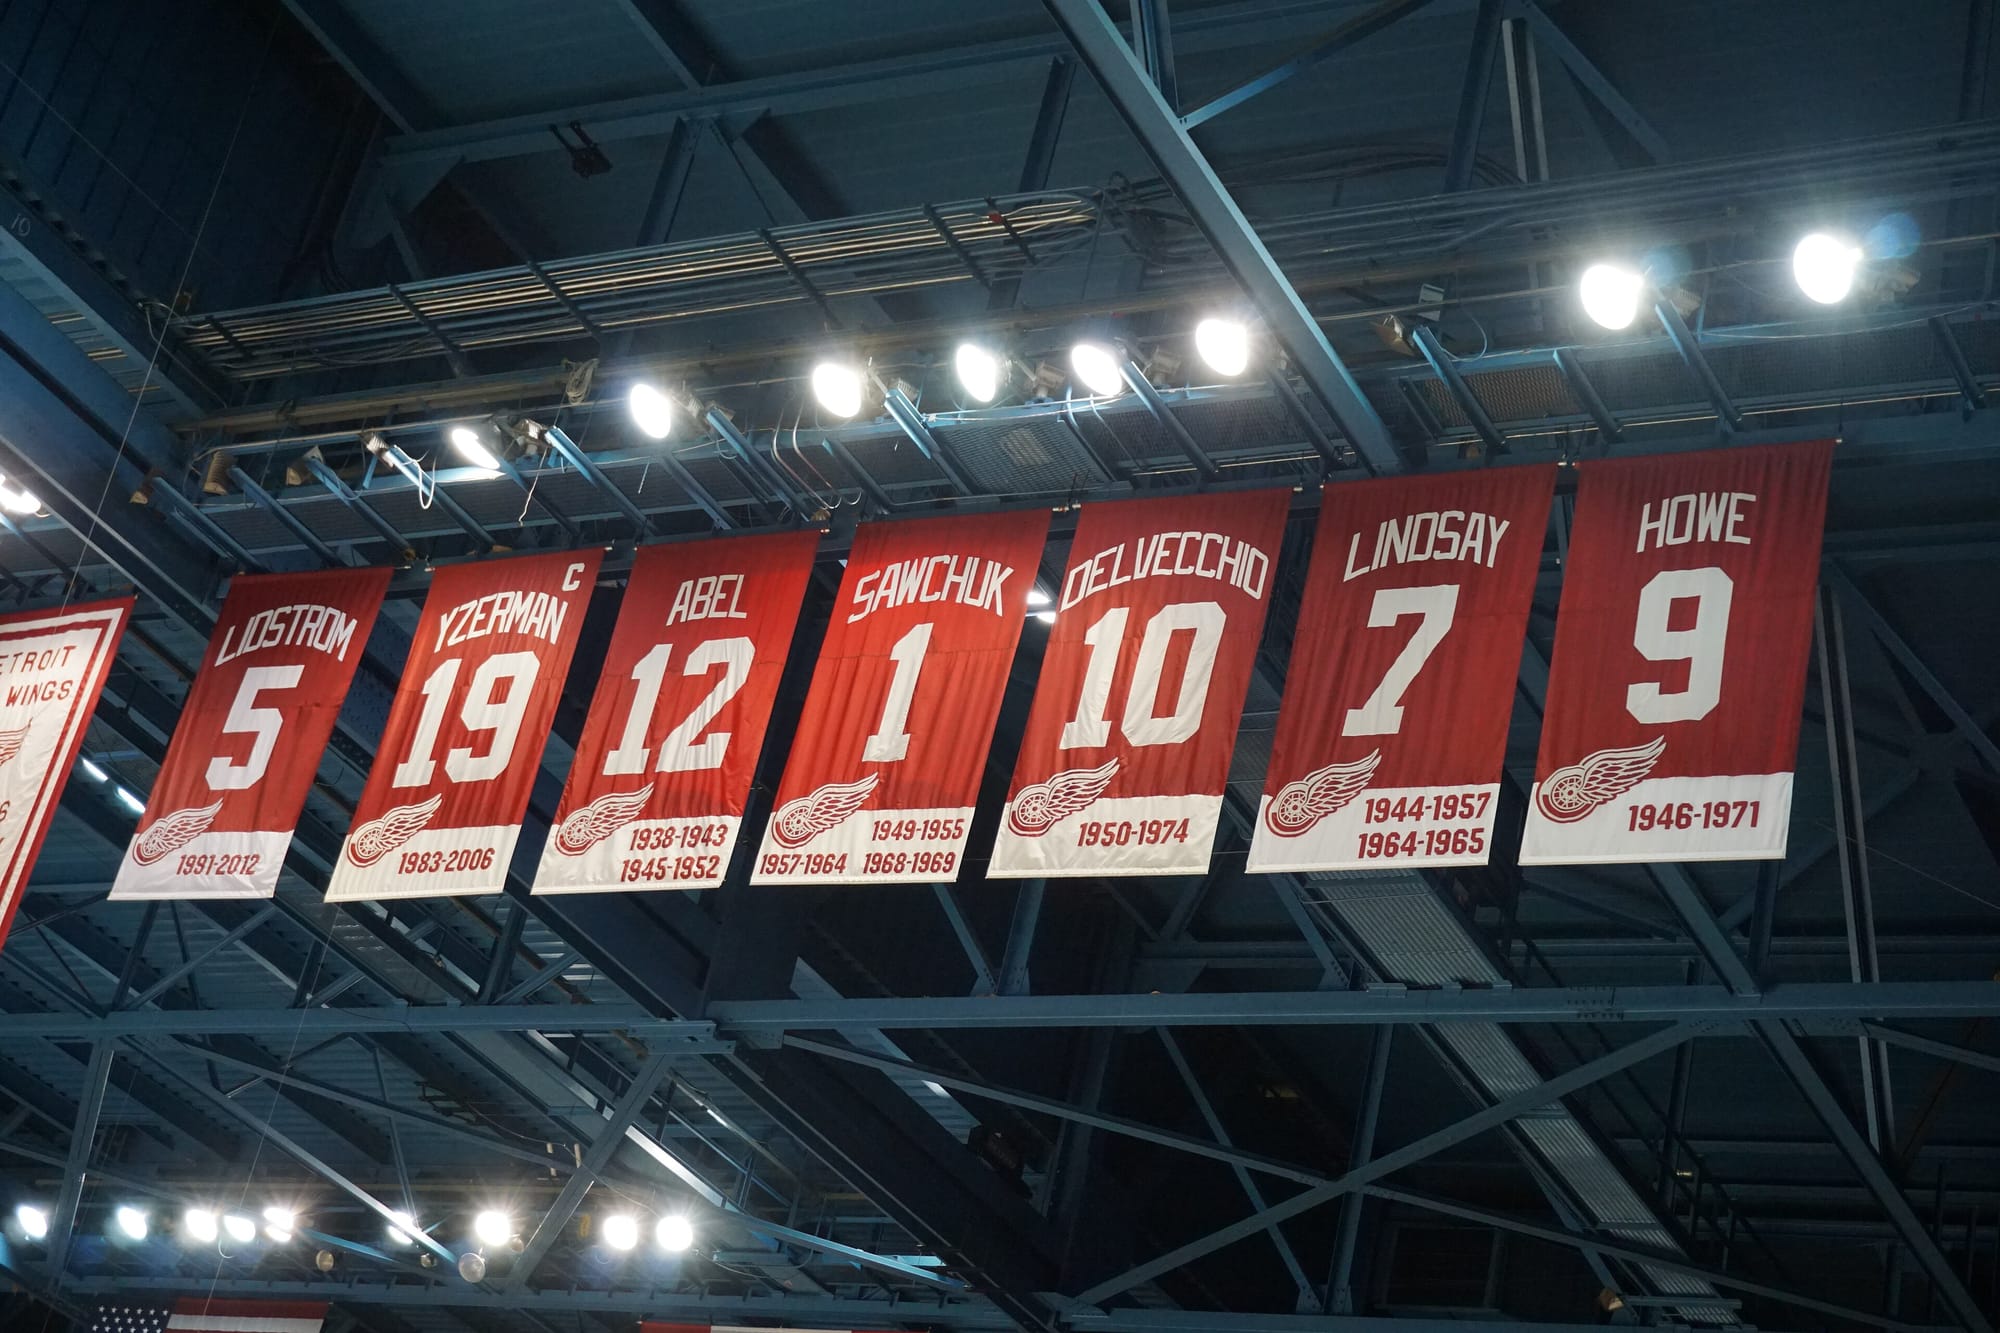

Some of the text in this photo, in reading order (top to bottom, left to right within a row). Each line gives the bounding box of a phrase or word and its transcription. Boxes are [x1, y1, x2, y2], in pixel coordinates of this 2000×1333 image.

[1342, 510, 1511, 583] LINDSAY
[1635, 491, 1757, 553] HOWE
[561, 562, 586, 592] C
[665, 573, 748, 627] ABEL
[846, 554, 1015, 624] SAWCHUK
[1058, 530, 1270, 614] DELVECCHIO
[214, 604, 359, 667] LIDSTROM
[434, 590, 569, 654] YZERMAN
[1625, 566, 1735, 725] 9
[1058, 600, 1228, 751] 10
[1341, 583, 1461, 737] 7
[6, 680, 74, 708] WINGS
[391, 650, 541, 788] 19
[602, 636, 756, 776] 12
[861, 622, 935, 762] 1
[205, 664, 305, 791] 5
[871, 818, 965, 842] 1949-1955
[1076, 818, 1189, 847] 1950-1974
[1363, 791, 1491, 824] 1944-1957
[1627, 800, 1760, 832] 1946-1971
[176, 853, 261, 876] 1991-2012
[398, 847, 496, 875] 1983-2006
[629, 823, 729, 852] 1938-1943
[758, 851, 956, 876] 1957-1964 1968-1969
[1357, 827, 1485, 859] 1964-1965
[619, 856, 721, 883] 1945-1952
